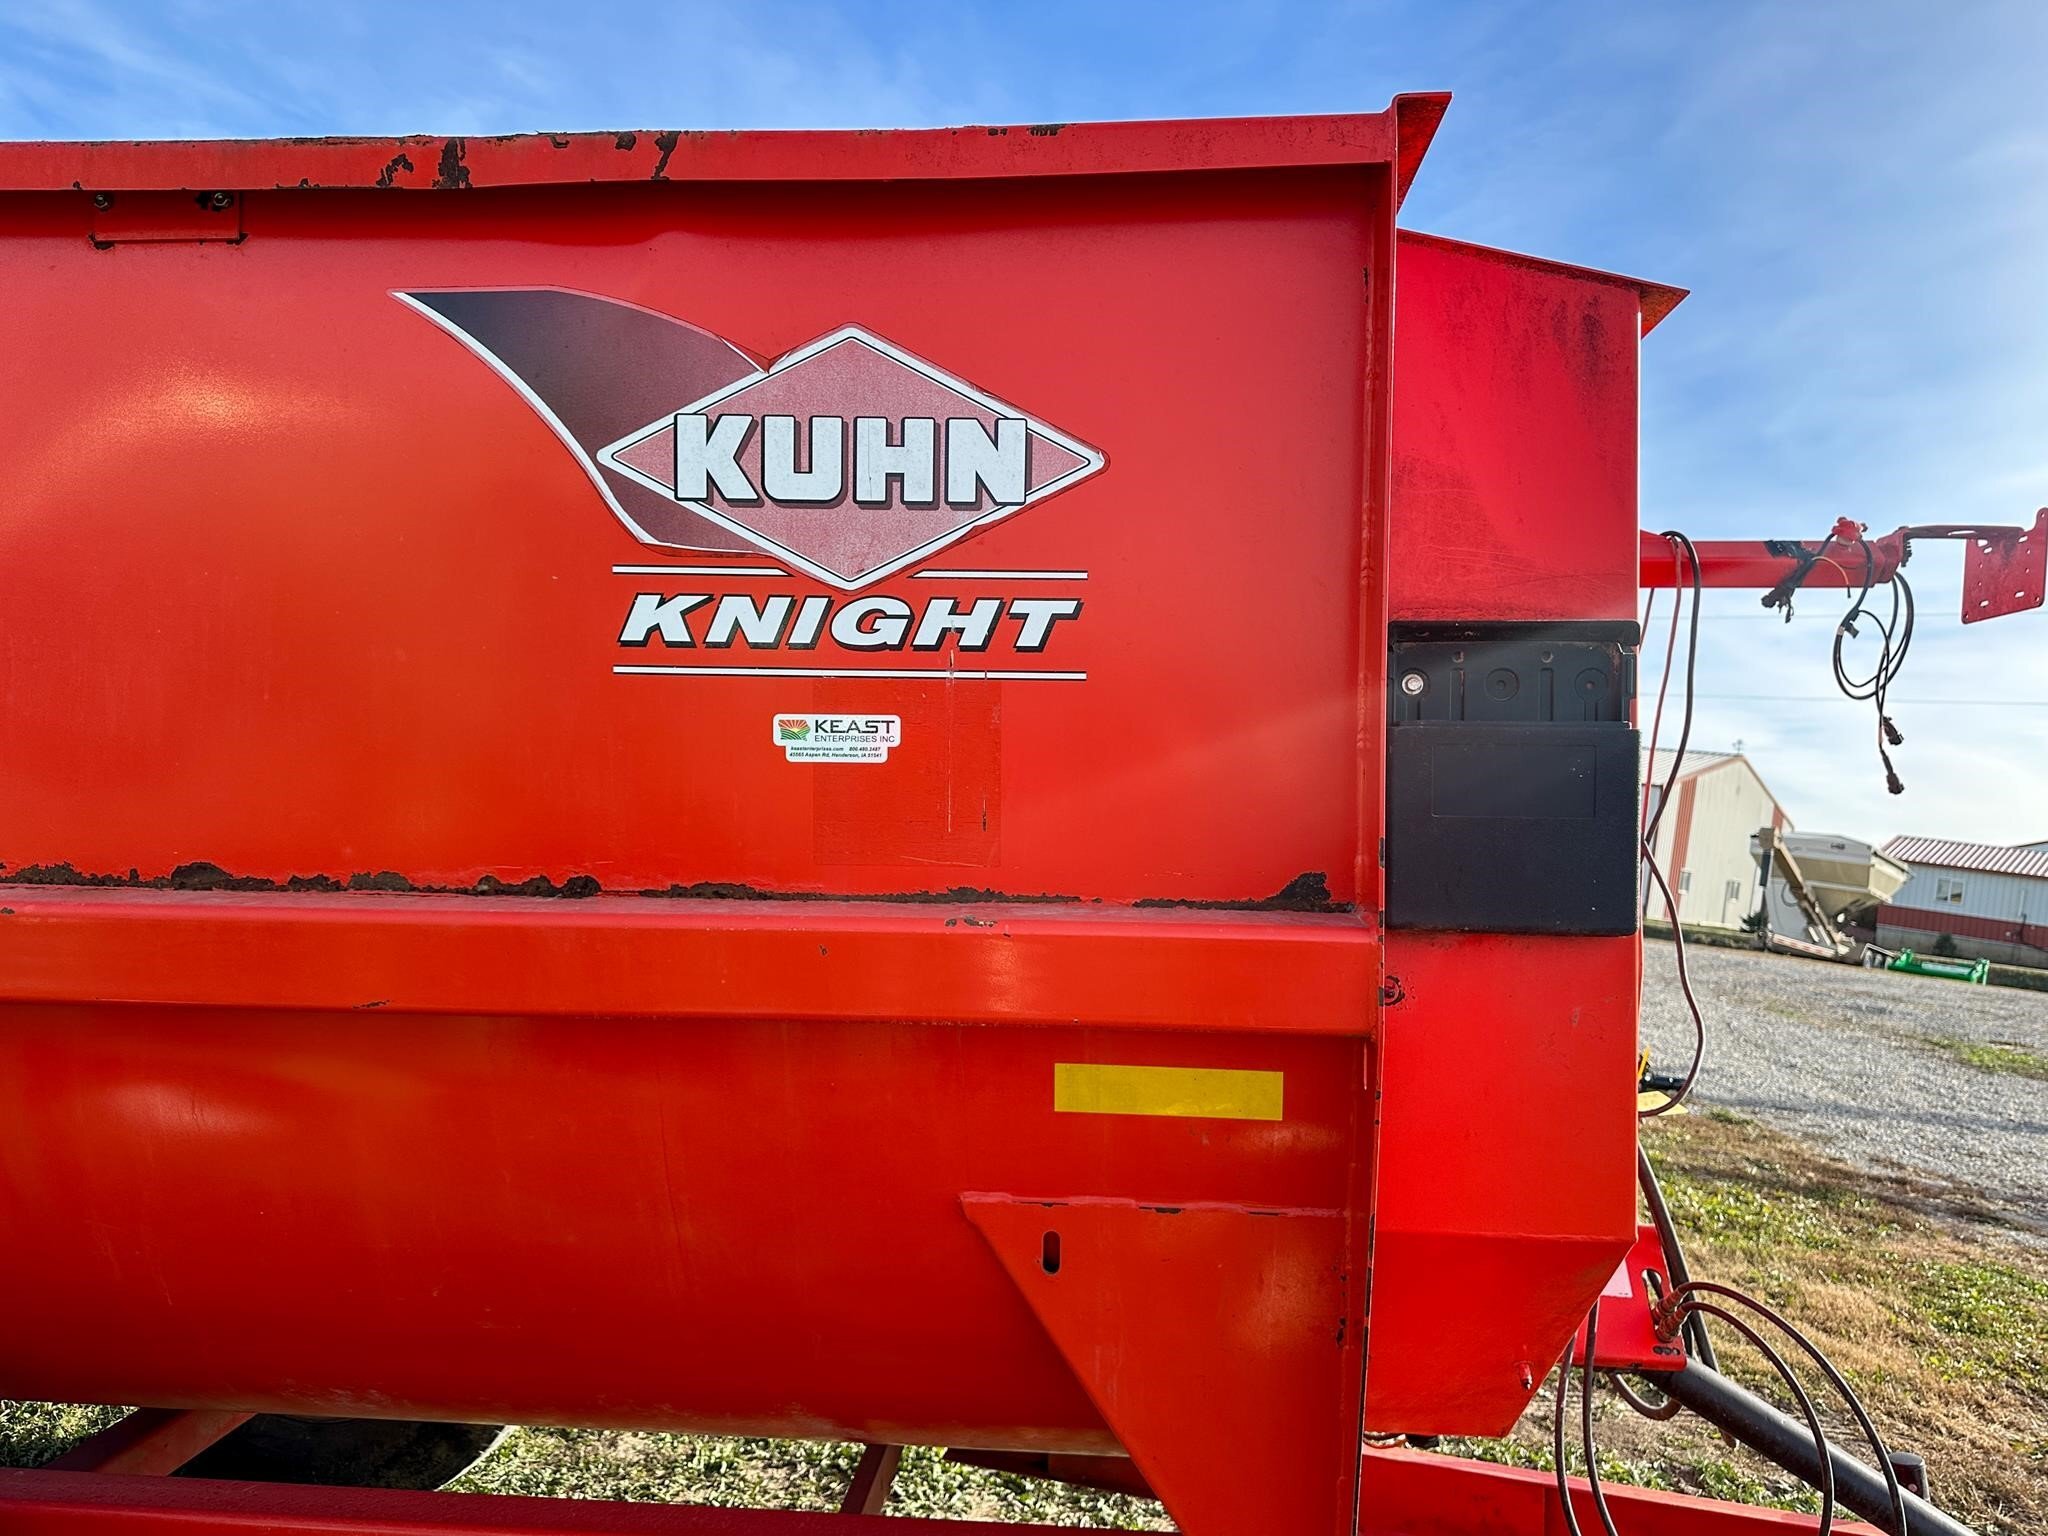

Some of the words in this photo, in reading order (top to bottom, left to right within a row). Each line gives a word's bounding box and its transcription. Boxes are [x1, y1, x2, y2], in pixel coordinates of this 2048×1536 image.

[674, 413, 1028, 505] KUHN
[617, 593, 1083, 652] KNIGHT
[814, 719, 895, 734] KEAST
[814, 734, 877, 743] ENTERPRISES
[879, 735, 895, 743] INC
